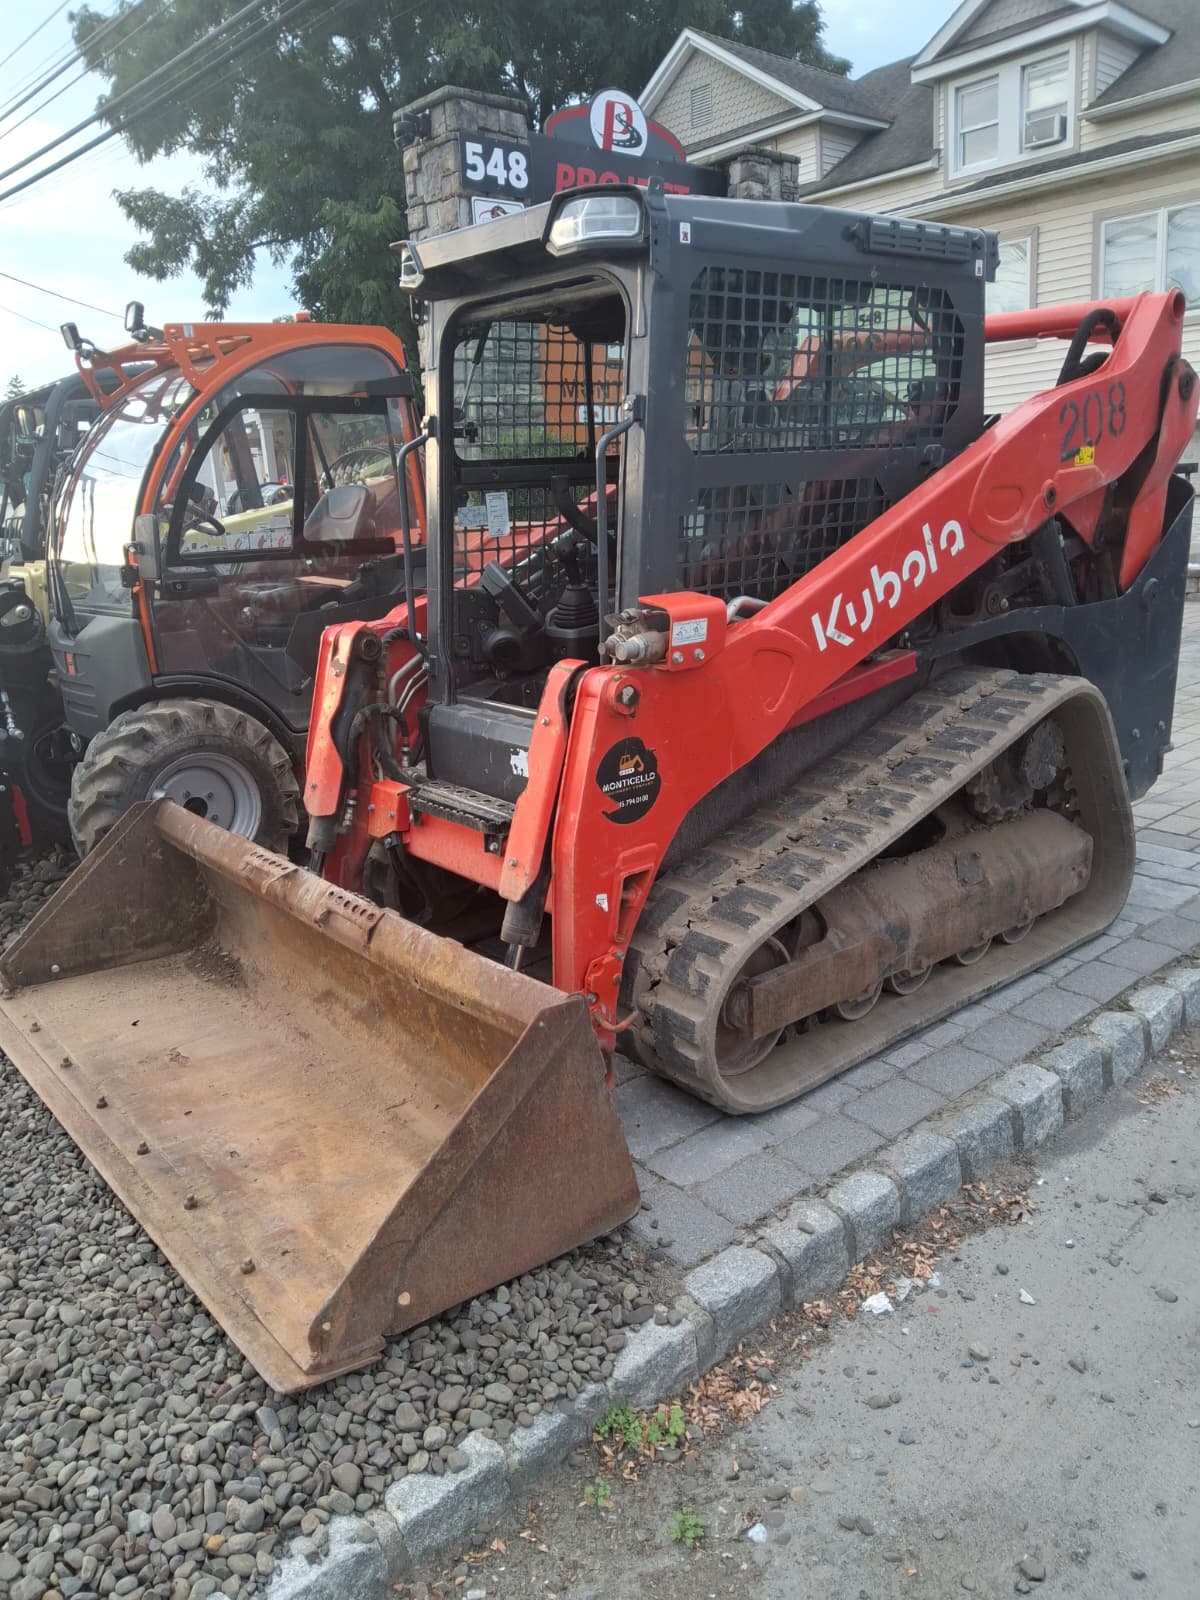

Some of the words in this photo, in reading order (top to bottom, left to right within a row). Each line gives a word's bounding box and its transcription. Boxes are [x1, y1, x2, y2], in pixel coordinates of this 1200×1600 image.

[465, 141, 529, 189] 548
[1058, 380, 1127, 463] 208
[810, 518, 966, 652] Kubota
[602, 771, 656, 793] MONTICELLO
